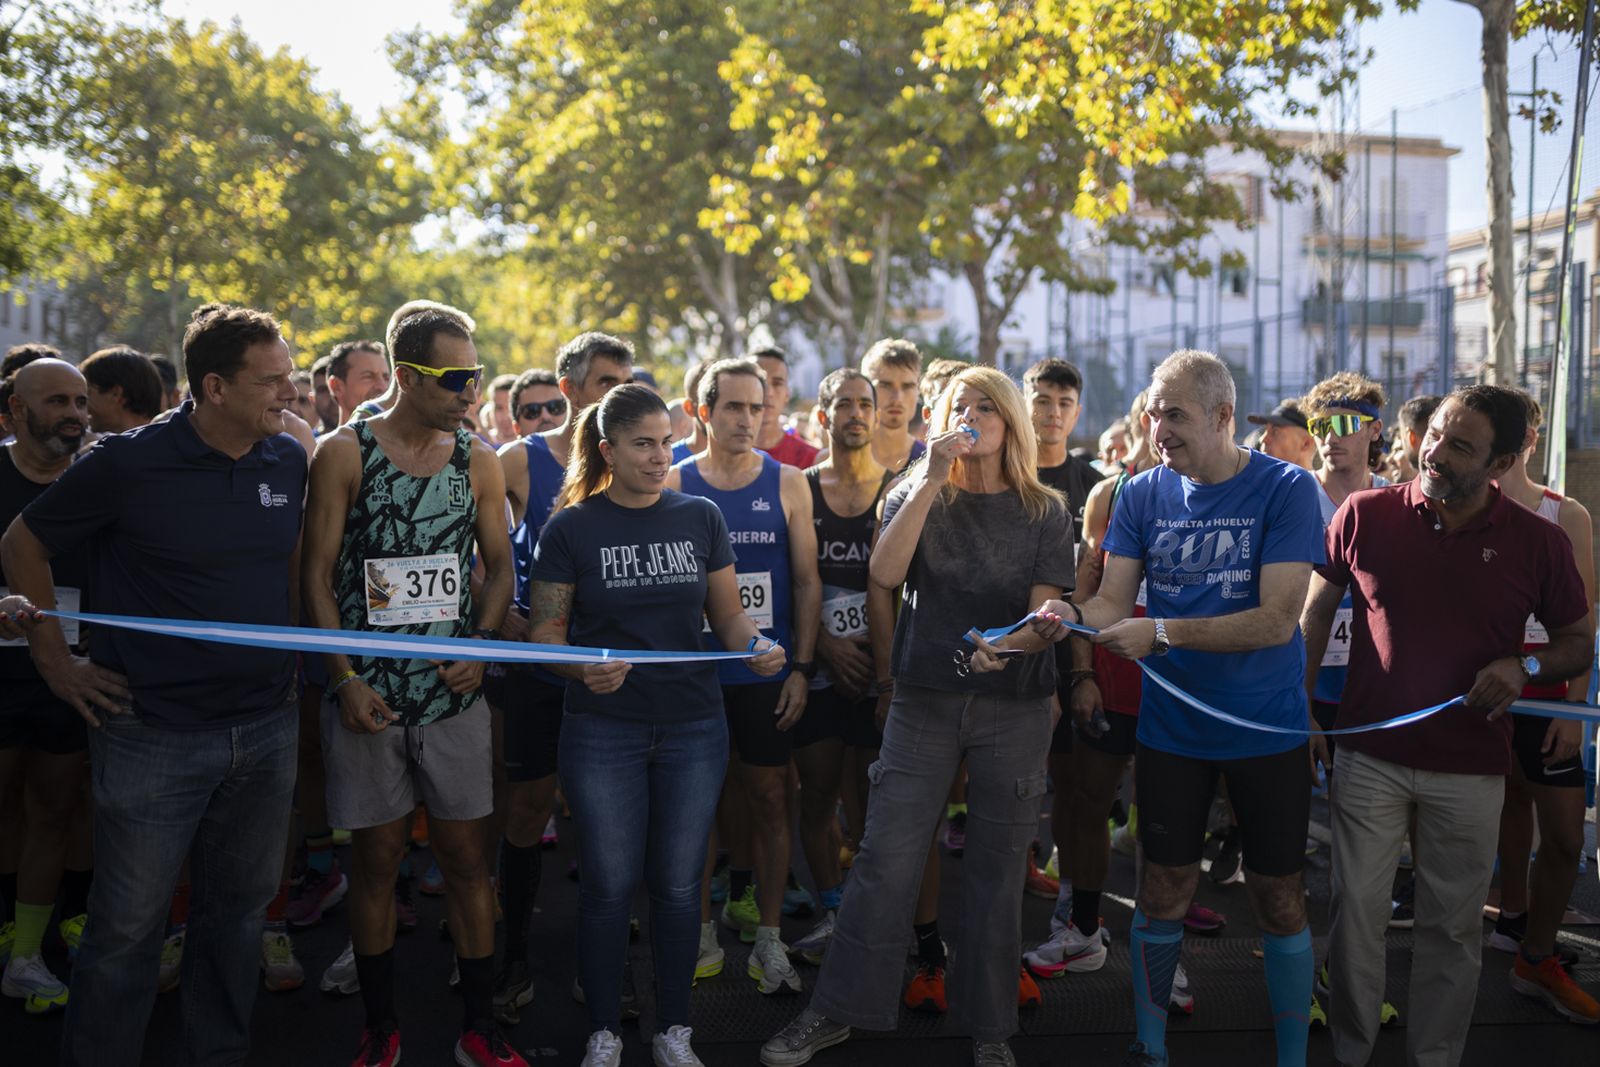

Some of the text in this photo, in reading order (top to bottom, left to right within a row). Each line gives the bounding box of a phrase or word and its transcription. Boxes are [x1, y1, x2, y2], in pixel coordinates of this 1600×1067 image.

[1156, 519, 1166, 527] 36
[1168, 519, 1204, 528] VUELTA
[1213, 518, 1255, 526] HUELVA
[729, 531, 776, 544] SIERRA
[1241, 534, 1250, 559] 2023
[600, 541, 698, 580] PEPE JEANS
[1149, 529, 1250, 572] RUN
[405, 568, 457, 598] 376
[606, 574, 699, 588] BORN IN LONDON
